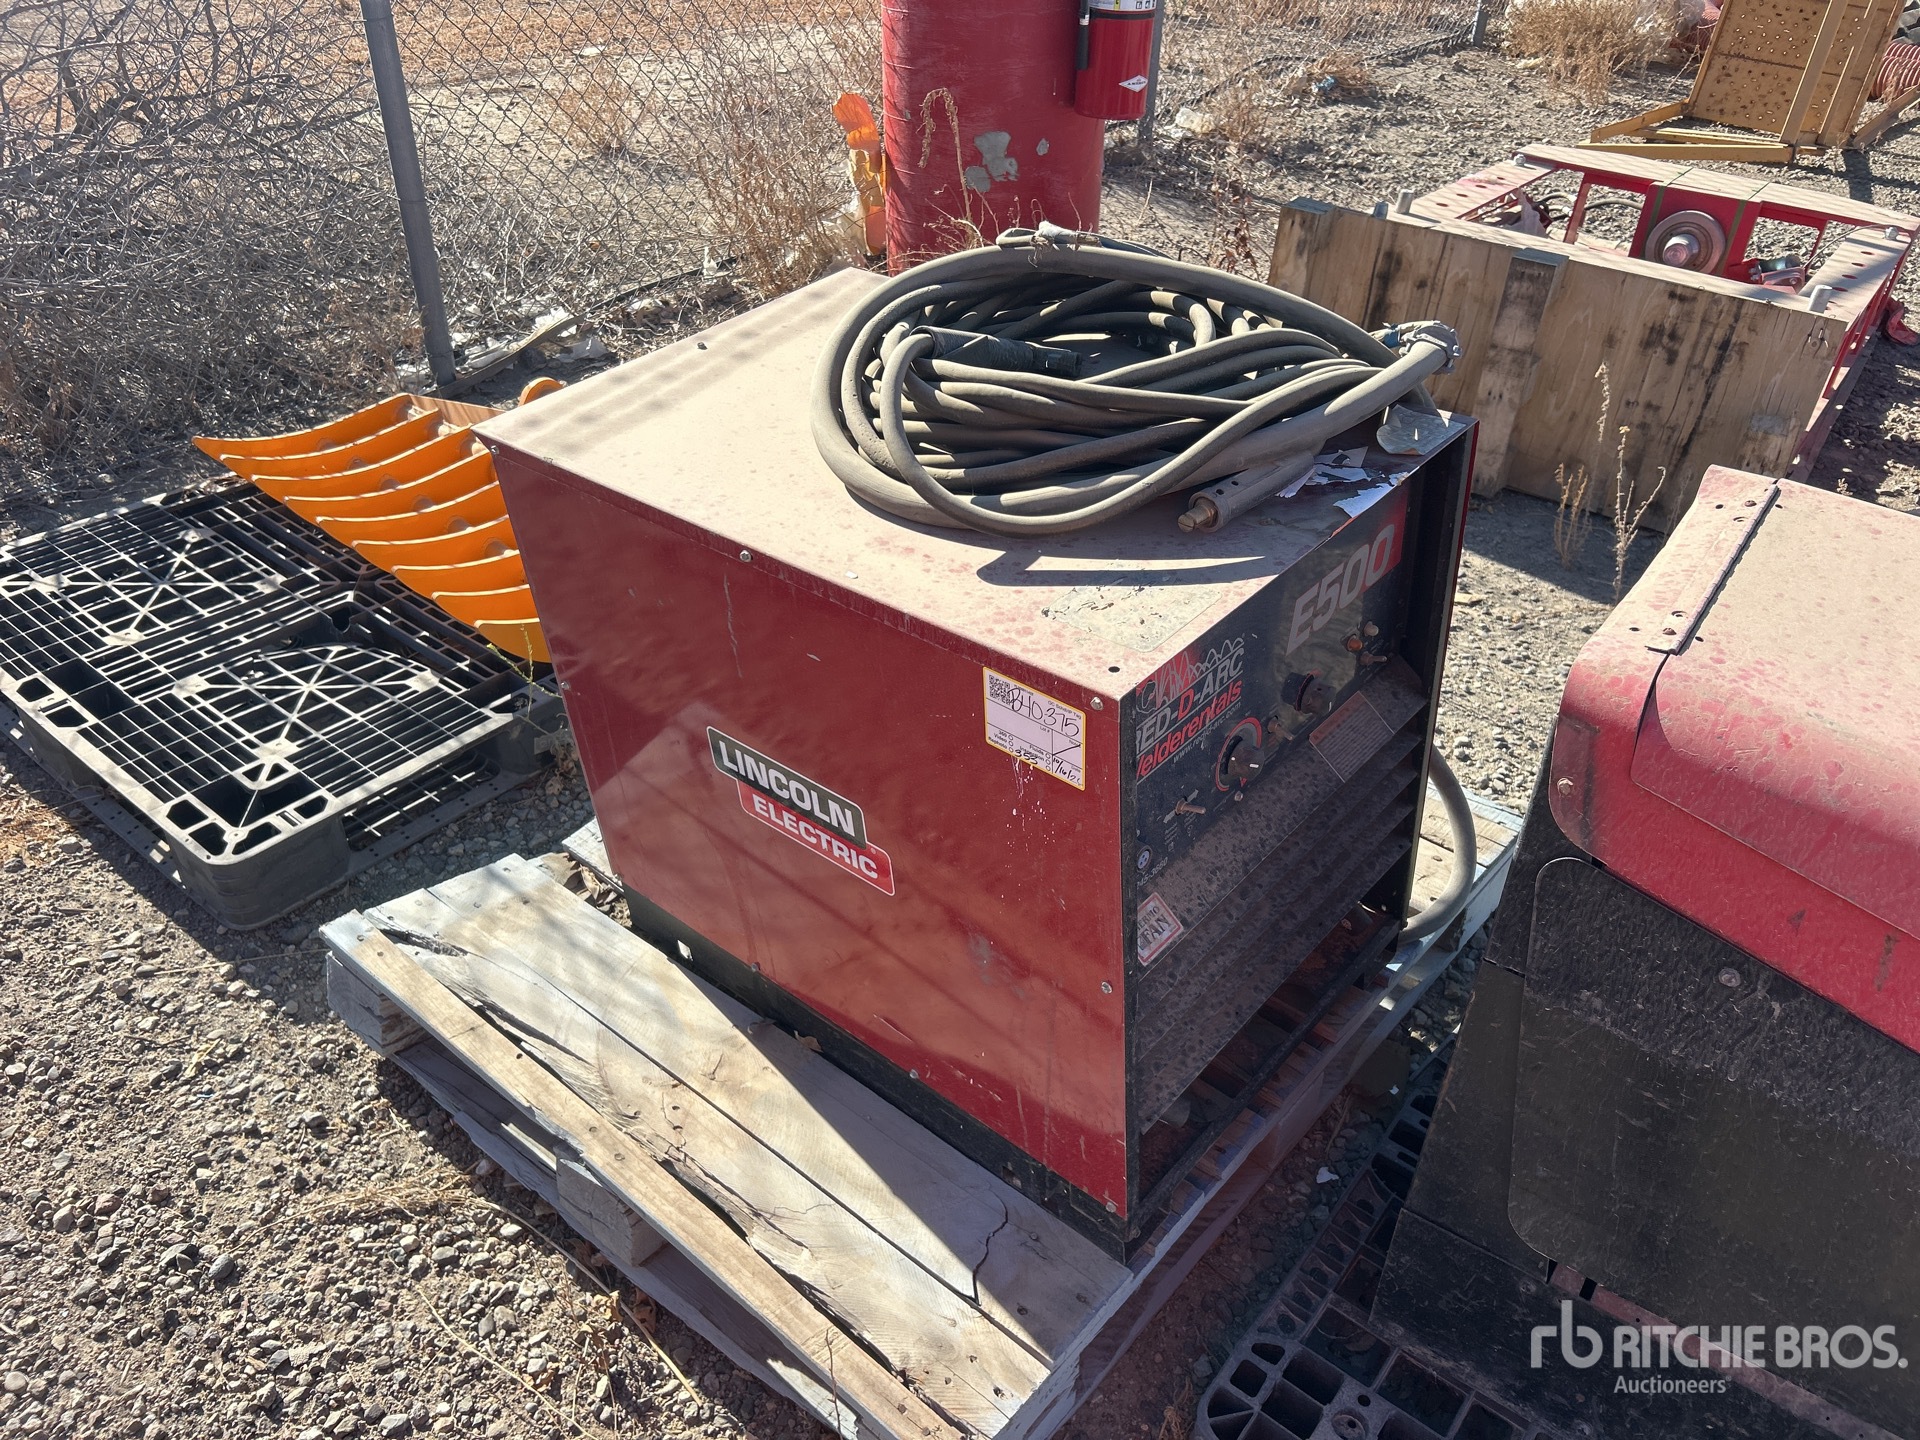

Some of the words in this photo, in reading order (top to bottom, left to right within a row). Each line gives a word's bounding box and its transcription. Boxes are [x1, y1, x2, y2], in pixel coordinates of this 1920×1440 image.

[1285, 524, 1395, 657] E500
[1136, 680, 1243, 780] elderentals
[719, 740, 856, 837] LINCOLN
[752, 793, 878, 879] ELECTRIC
[1140, 913, 1171, 946] FAN
